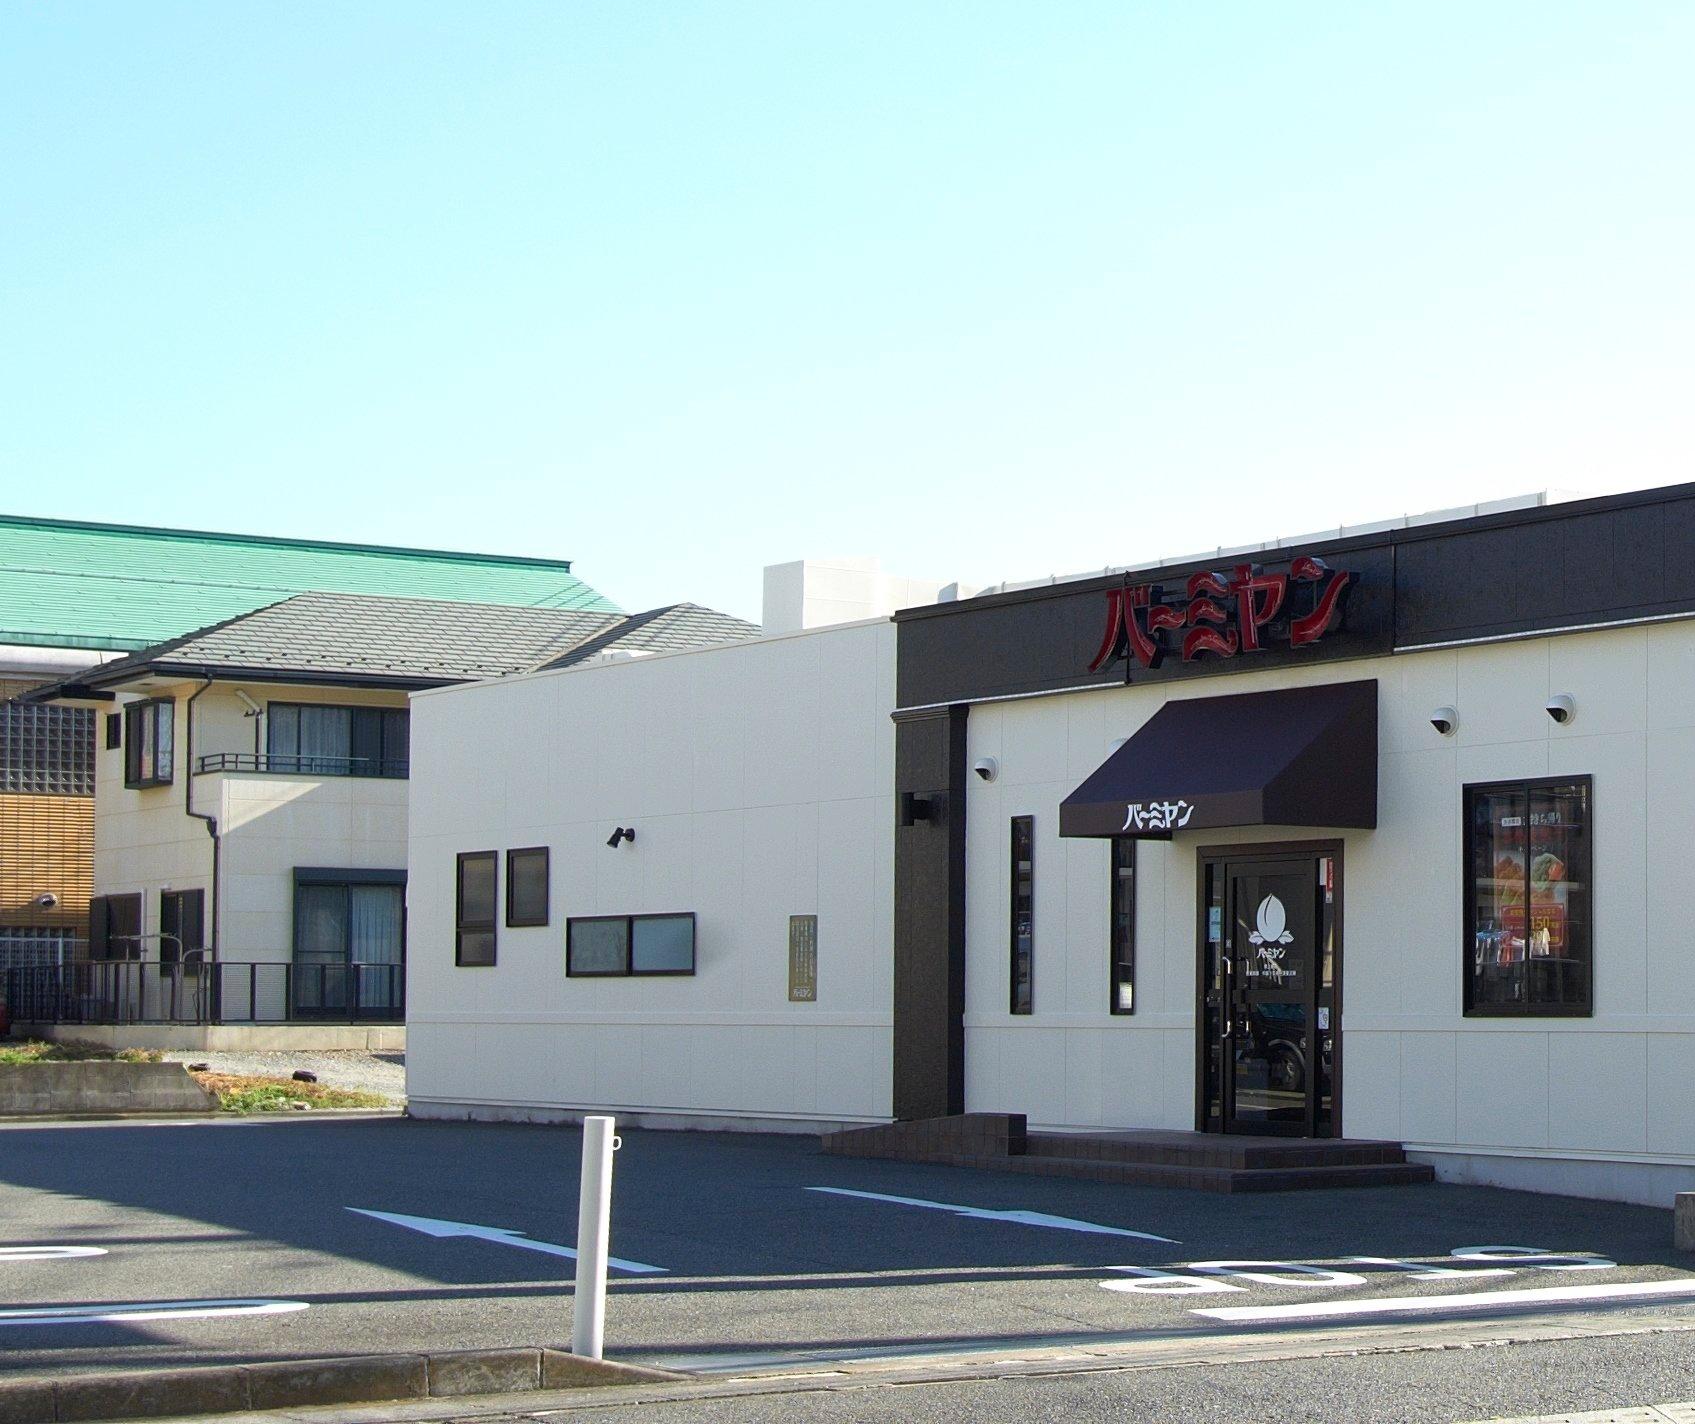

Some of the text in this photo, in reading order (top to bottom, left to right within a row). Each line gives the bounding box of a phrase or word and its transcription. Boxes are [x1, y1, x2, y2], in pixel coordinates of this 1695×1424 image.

[1089, 557, 1352, 672] バーミヤン
[1122, 800, 1194, 831] バーミヤン
[1098, 1245, 1618, 1295] STOP
